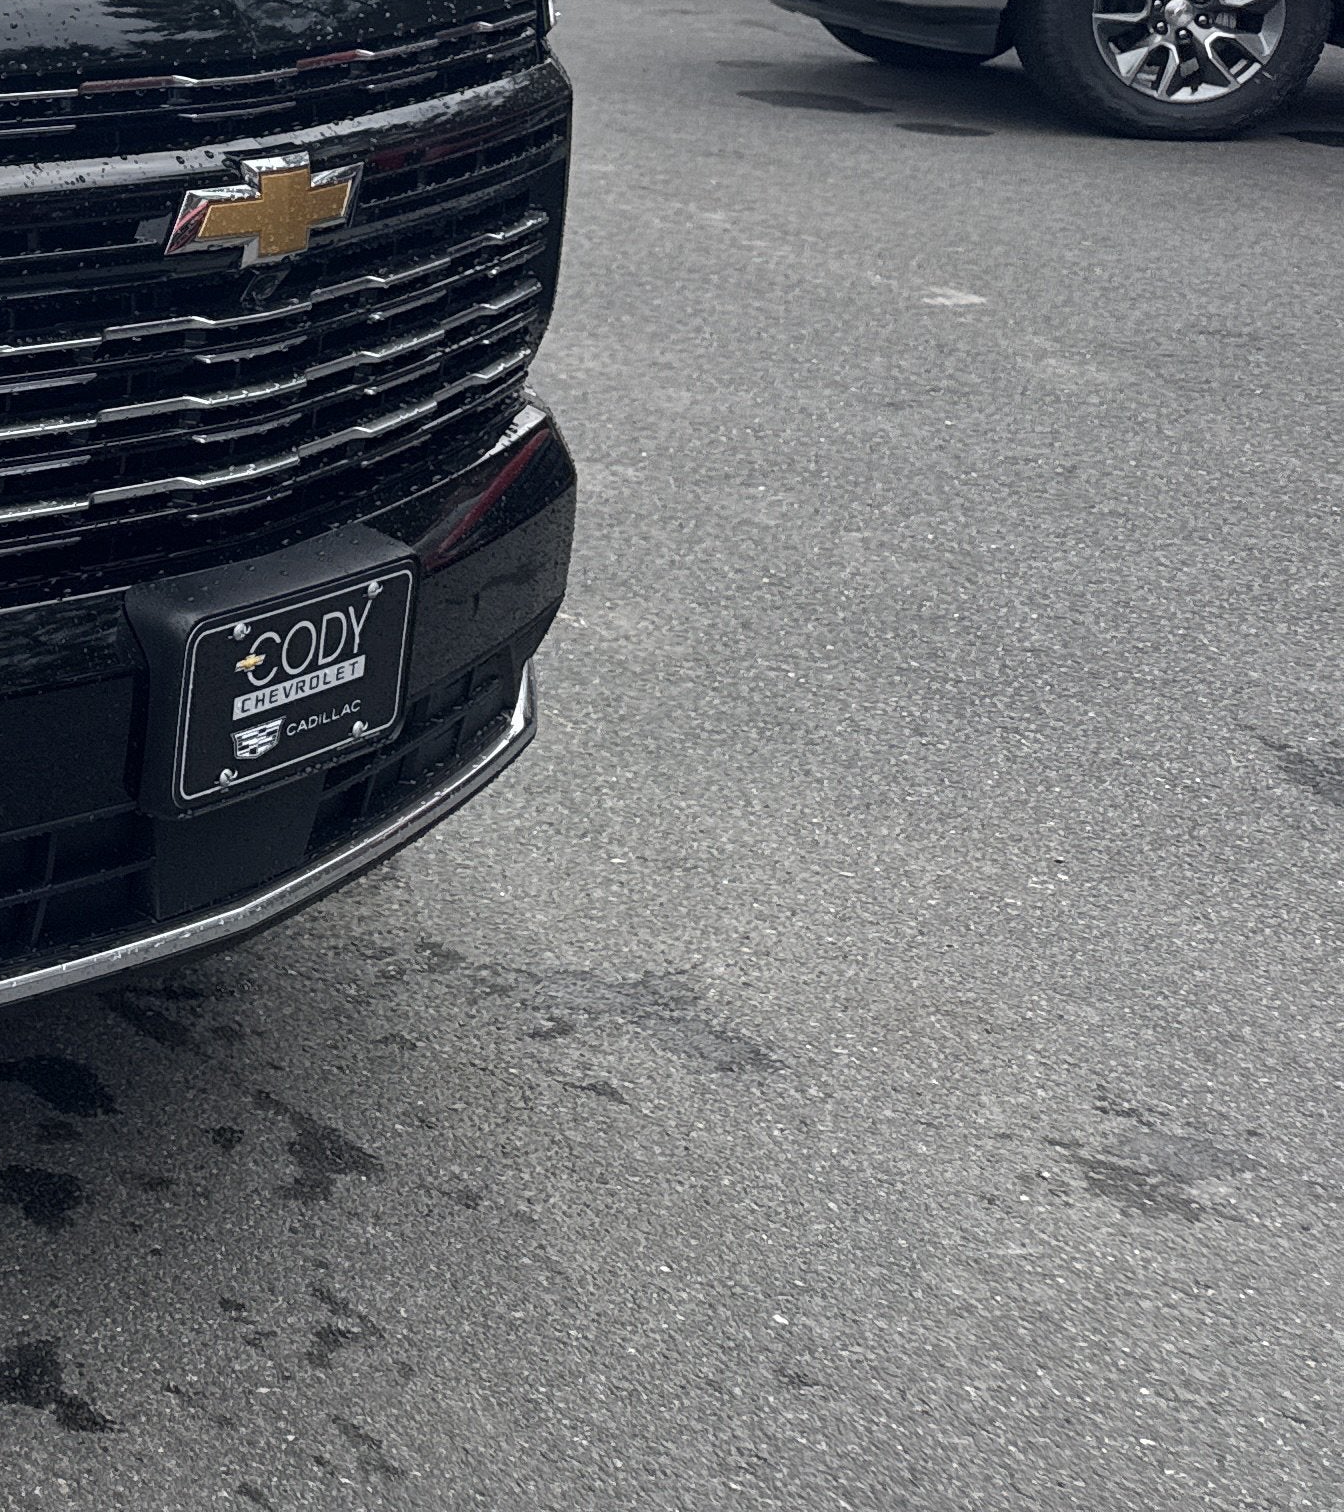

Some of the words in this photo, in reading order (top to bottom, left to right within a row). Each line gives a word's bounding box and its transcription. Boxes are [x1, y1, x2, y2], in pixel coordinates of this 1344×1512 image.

[246, 598, 373, 687] CODY
[240, 659, 360, 714] CHEVROLET
[285, 699, 362, 737] CADILLAC
